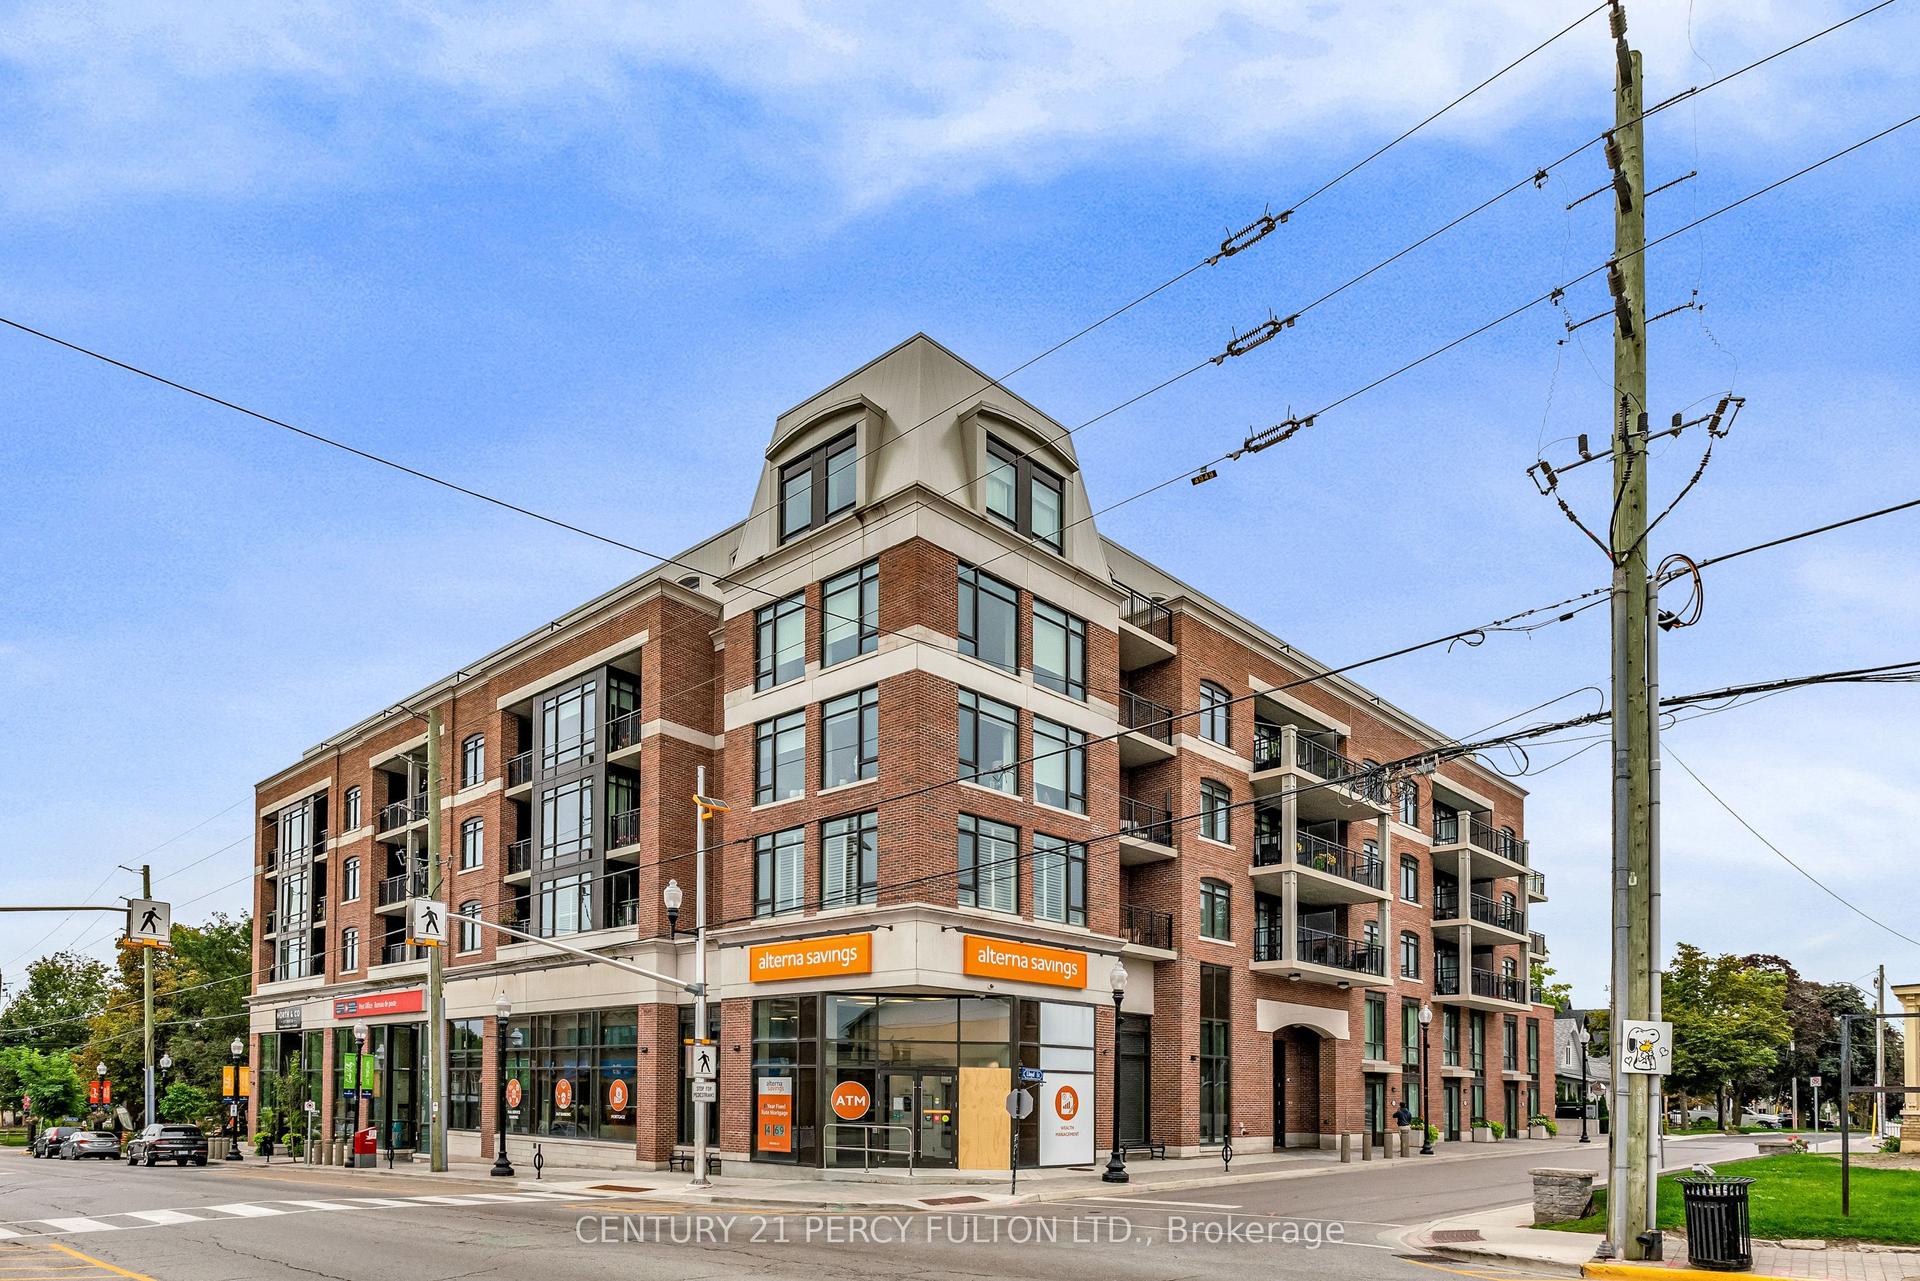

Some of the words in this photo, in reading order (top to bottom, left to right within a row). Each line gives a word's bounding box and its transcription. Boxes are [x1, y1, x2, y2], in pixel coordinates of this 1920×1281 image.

[758, 952, 804, 970] alterna
[806, 947, 857, 967] savings
[978, 945, 1028, 969] alterna
[1031, 957, 1078, 980] savings
[835, 1095, 866, 1107] ATM
